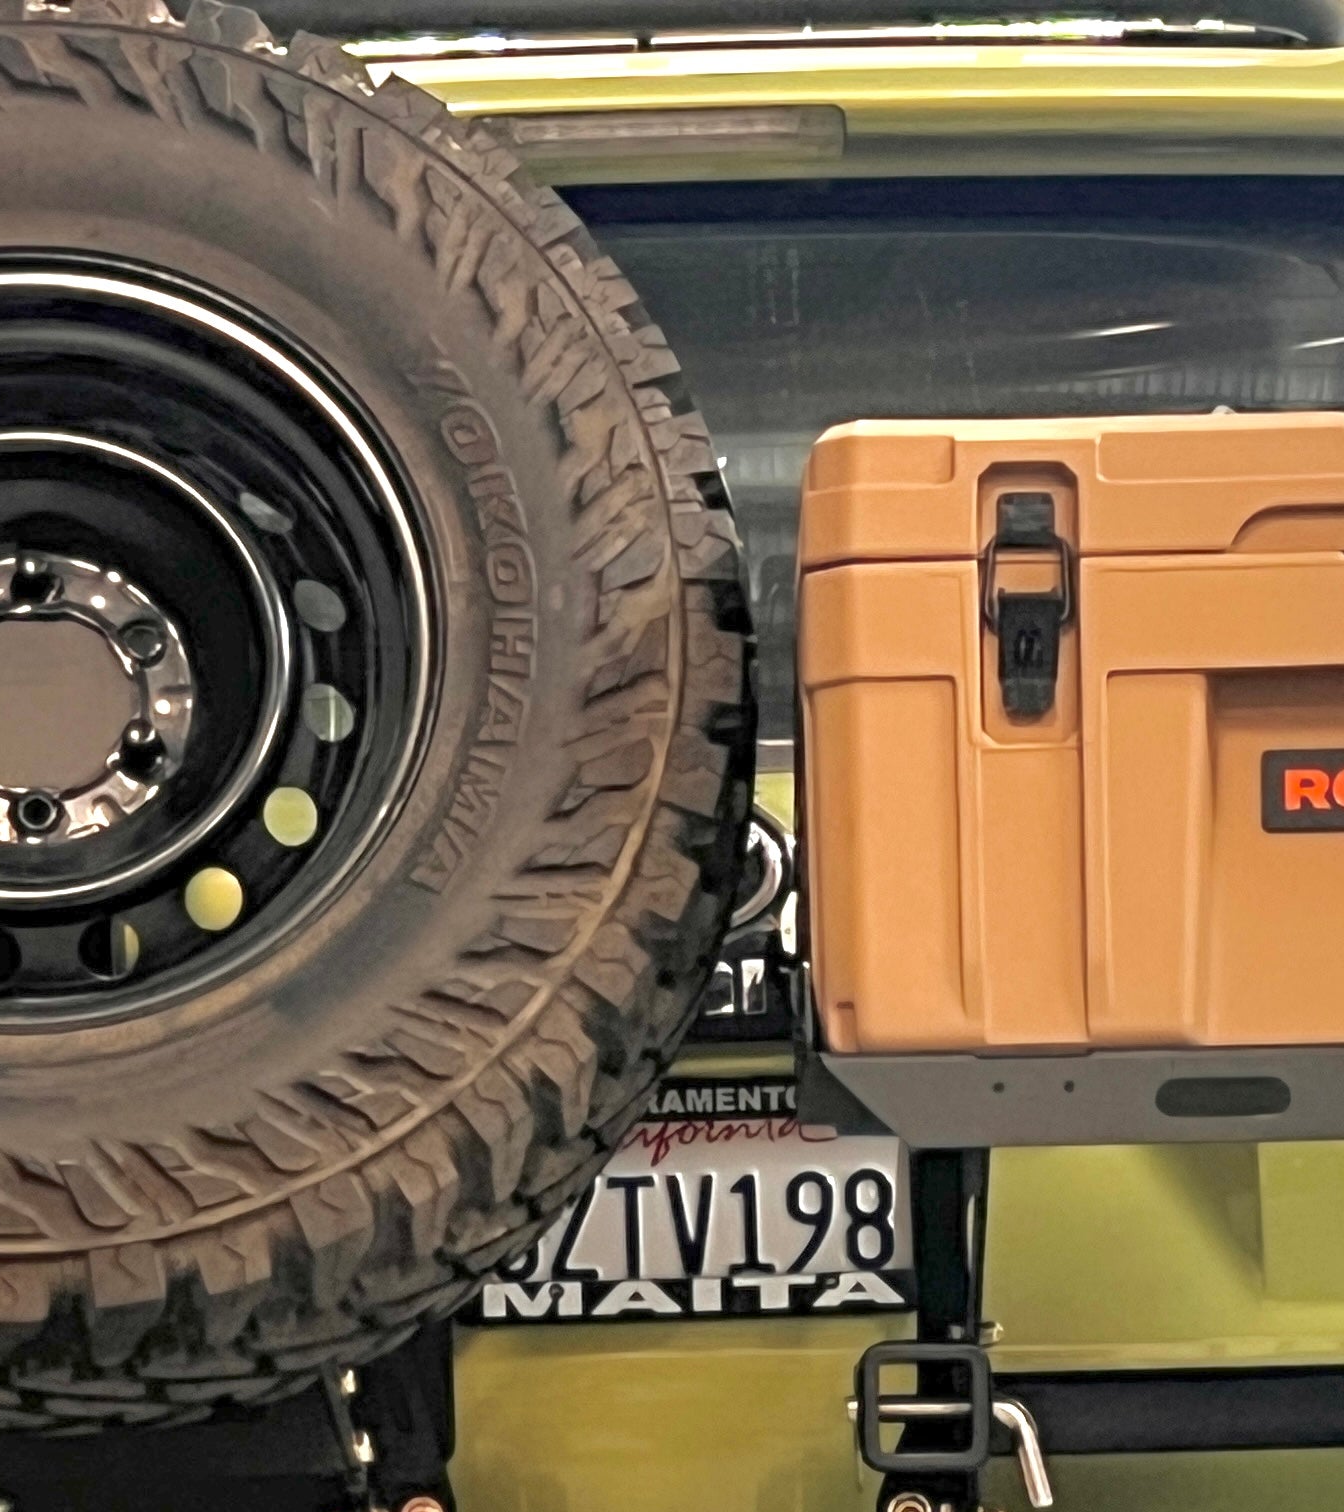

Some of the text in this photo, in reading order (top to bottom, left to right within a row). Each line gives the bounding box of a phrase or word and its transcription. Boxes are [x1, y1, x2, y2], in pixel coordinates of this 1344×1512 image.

[404, 334, 538, 895] YOKOHAMA
[621, 1116, 838, 1167] ifornia
[483, 1271, 906, 1319] MAITA
